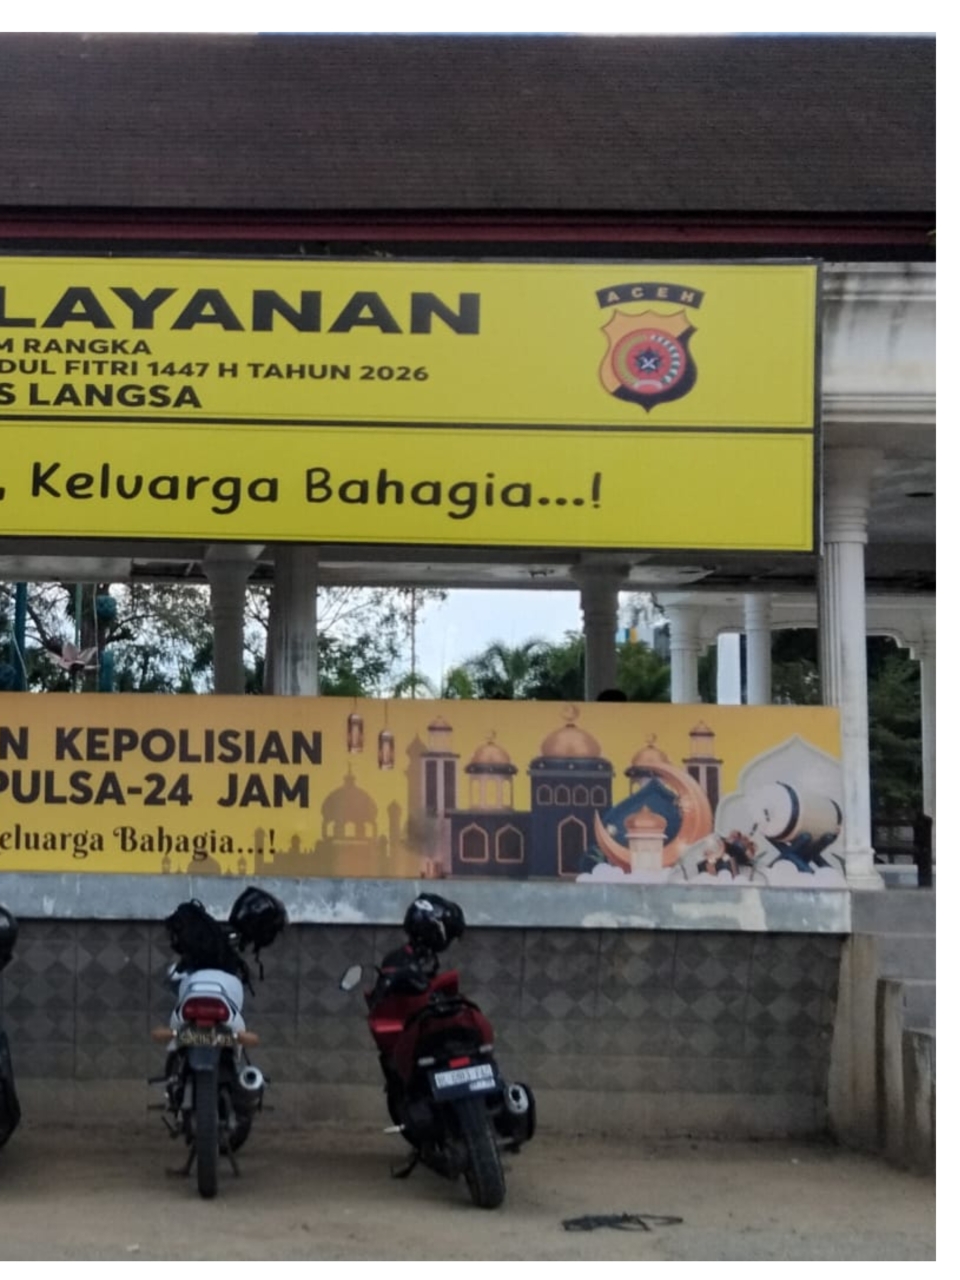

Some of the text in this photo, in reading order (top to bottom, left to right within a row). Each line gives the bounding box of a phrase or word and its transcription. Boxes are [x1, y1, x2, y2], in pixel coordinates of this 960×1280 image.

[606, 286, 696, 304] ACEH
[23, 337, 152, 355] RANGKA
[64, 359, 138, 376] FITRI
[146, 361, 210, 378] 1447
[218, 362, 238, 378] H
[246, 362, 351, 380] TAHUN
[359, 365, 429, 382] 2026
[28, 382, 202, 410] LANGSA
[31, 461, 279, 515] Keluarga
[305, 466, 602, 520] Bahagia...!
[55, 726, 322, 765] KEPOLISIAN
[217, 772, 310, 809] JAM
[112, 825, 277, 860] Bahagia...!
